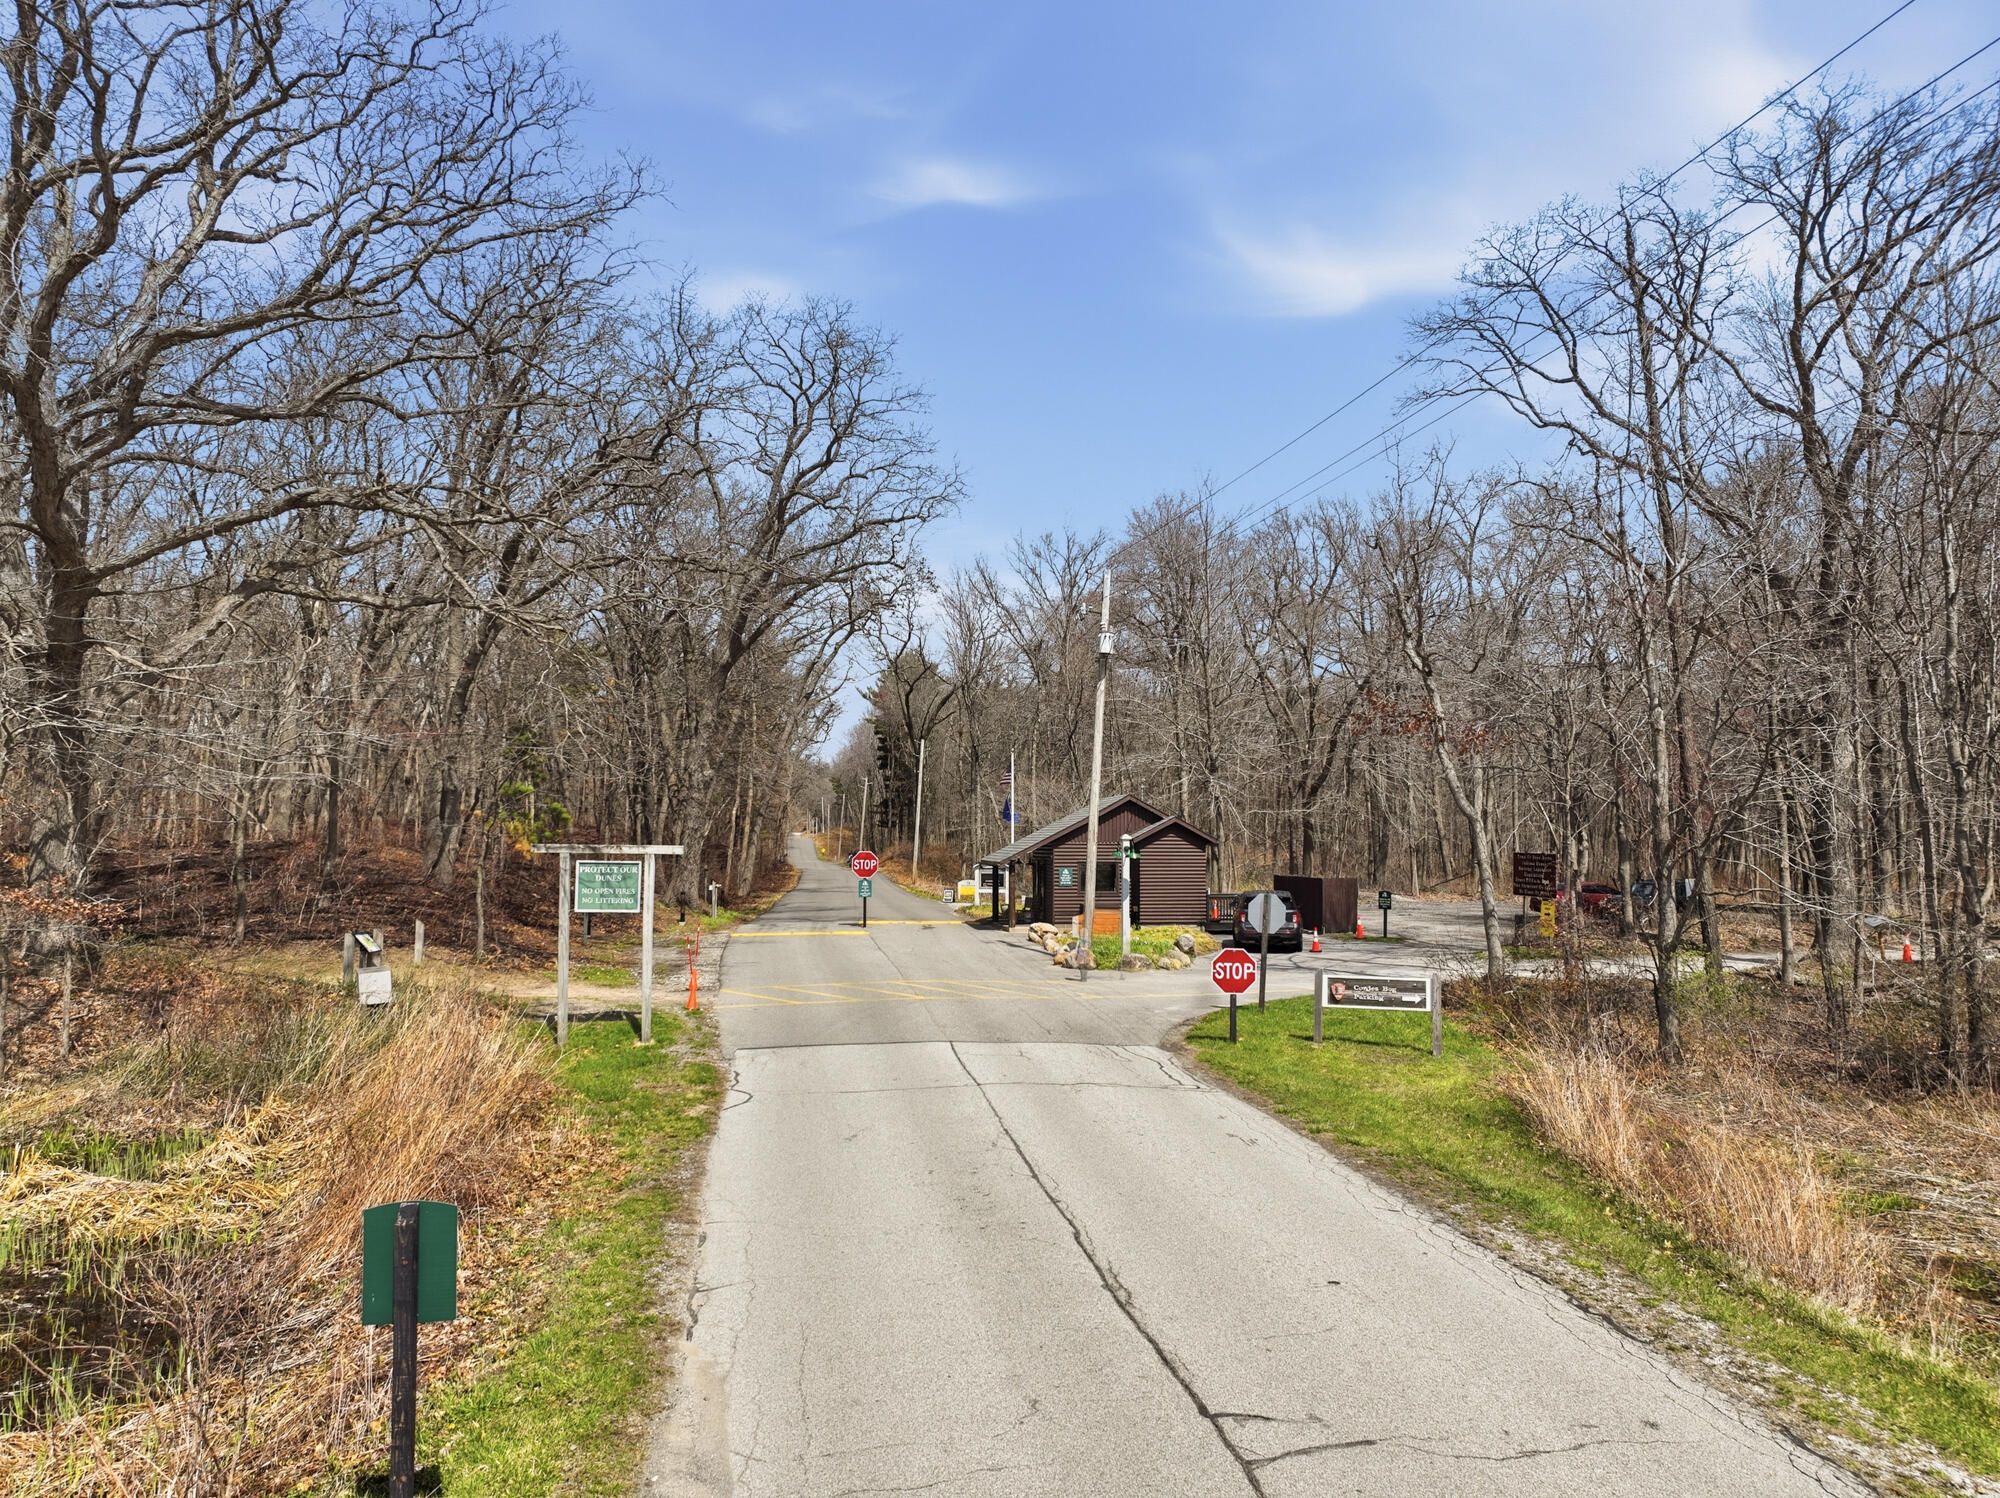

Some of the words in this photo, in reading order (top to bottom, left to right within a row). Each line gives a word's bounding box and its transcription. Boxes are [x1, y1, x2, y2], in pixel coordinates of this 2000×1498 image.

[853, 859, 877, 870] STOP
[1215, 962, 1253, 980] STOP
[1353, 993, 1384, 1001] Parking
